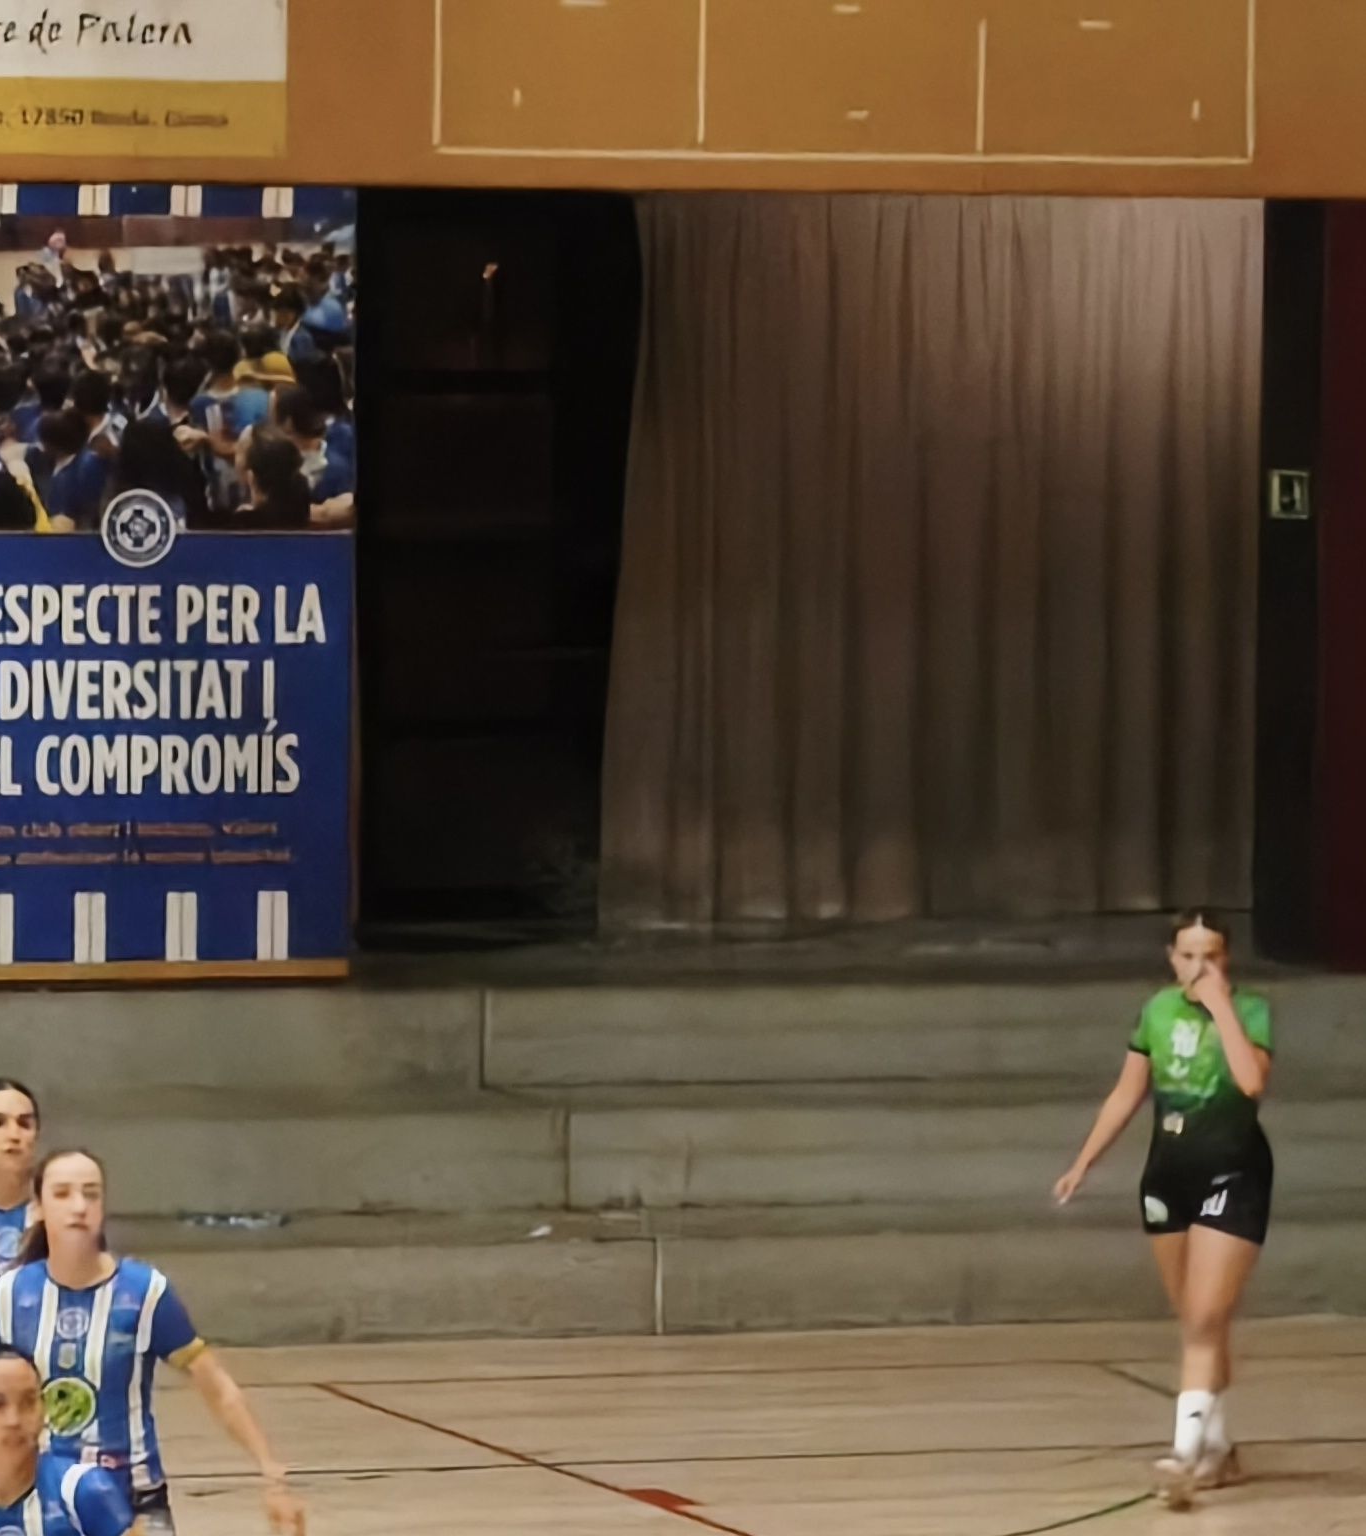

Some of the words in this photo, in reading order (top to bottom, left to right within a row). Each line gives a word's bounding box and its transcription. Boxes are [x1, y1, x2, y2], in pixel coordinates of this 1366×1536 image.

[29, 8, 61, 54] de
[77, 11, 192, 46] Palera
[176, 584, 260, 645] PER
[274, 583, 327, 644] LA
[262, 659, 275, 719] I
[35, 719, 300, 796] COMPROMÍS
